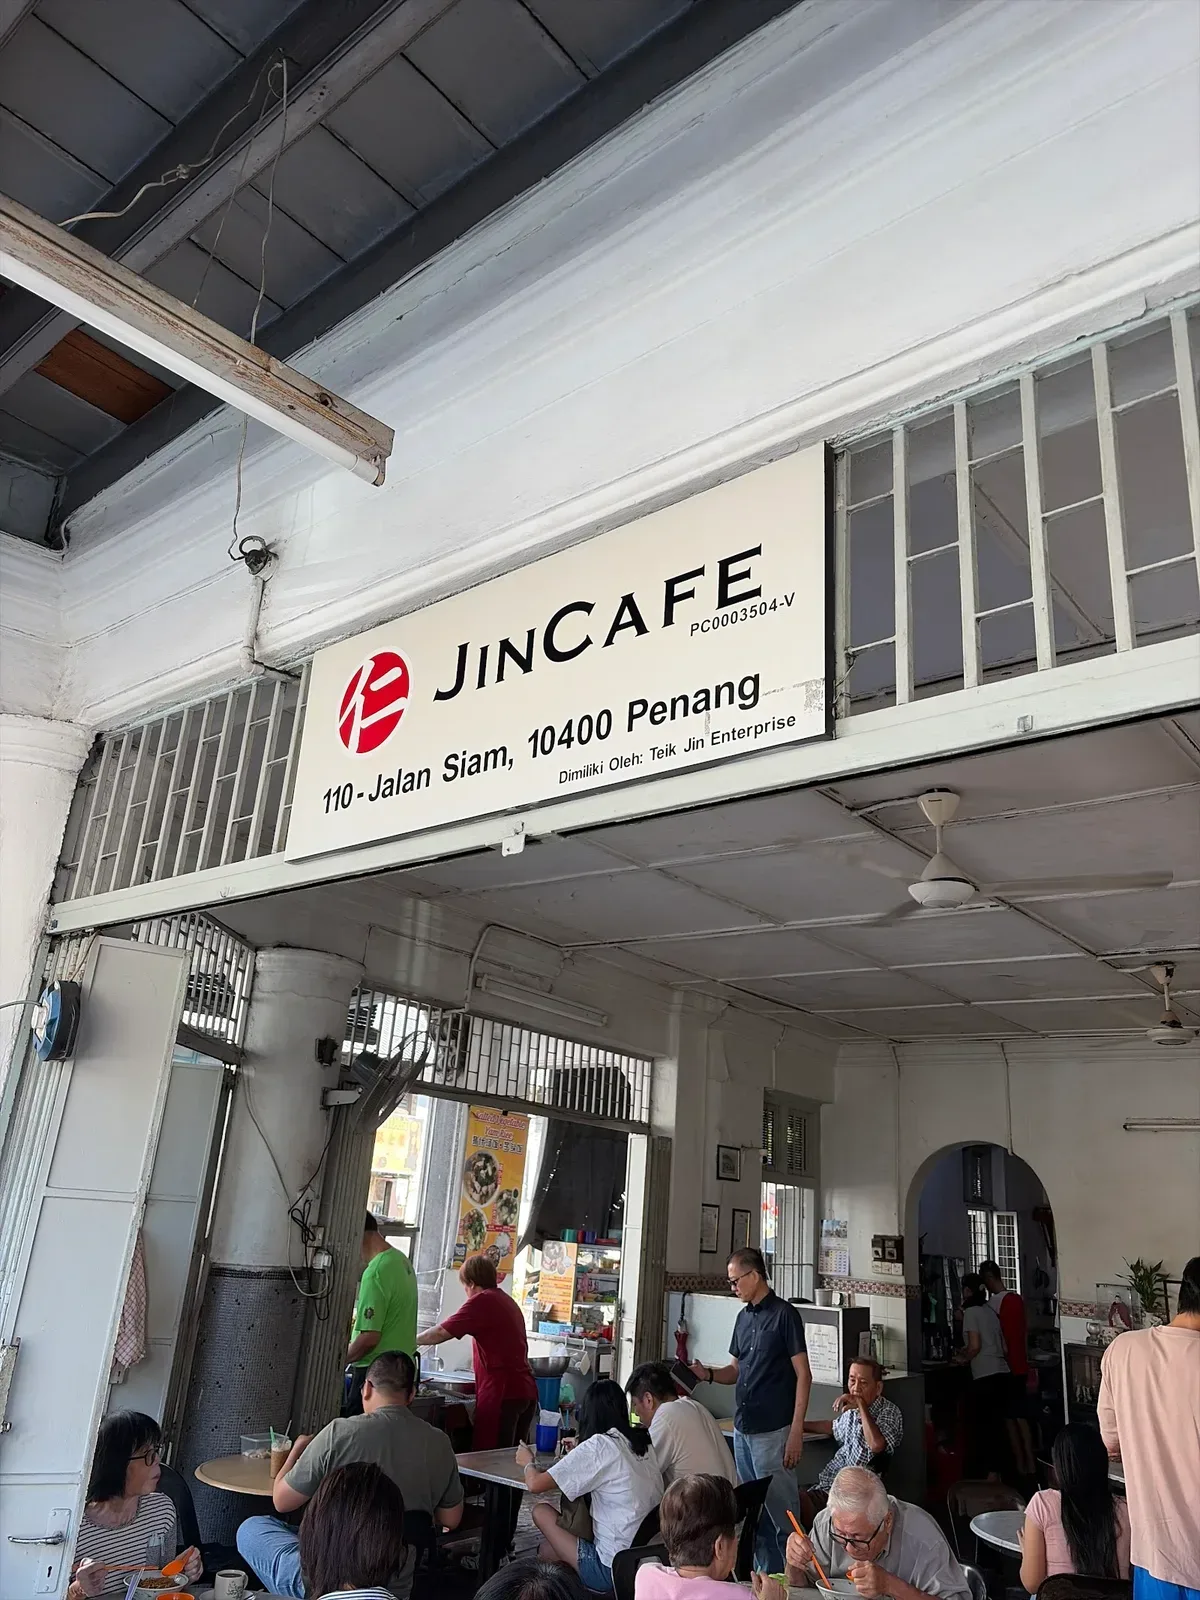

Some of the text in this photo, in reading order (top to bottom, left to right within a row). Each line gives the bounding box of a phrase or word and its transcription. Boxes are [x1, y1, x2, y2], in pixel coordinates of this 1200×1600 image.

[690, 592, 796, 637] PC0003504-V
[442, 745, 514, 783] Siam,
[527, 708, 613, 760] 10400
[627, 673, 760, 733] Penang
[559, 715, 796, 785] Dimiliki Oleh: Teik Jin Enterprise
